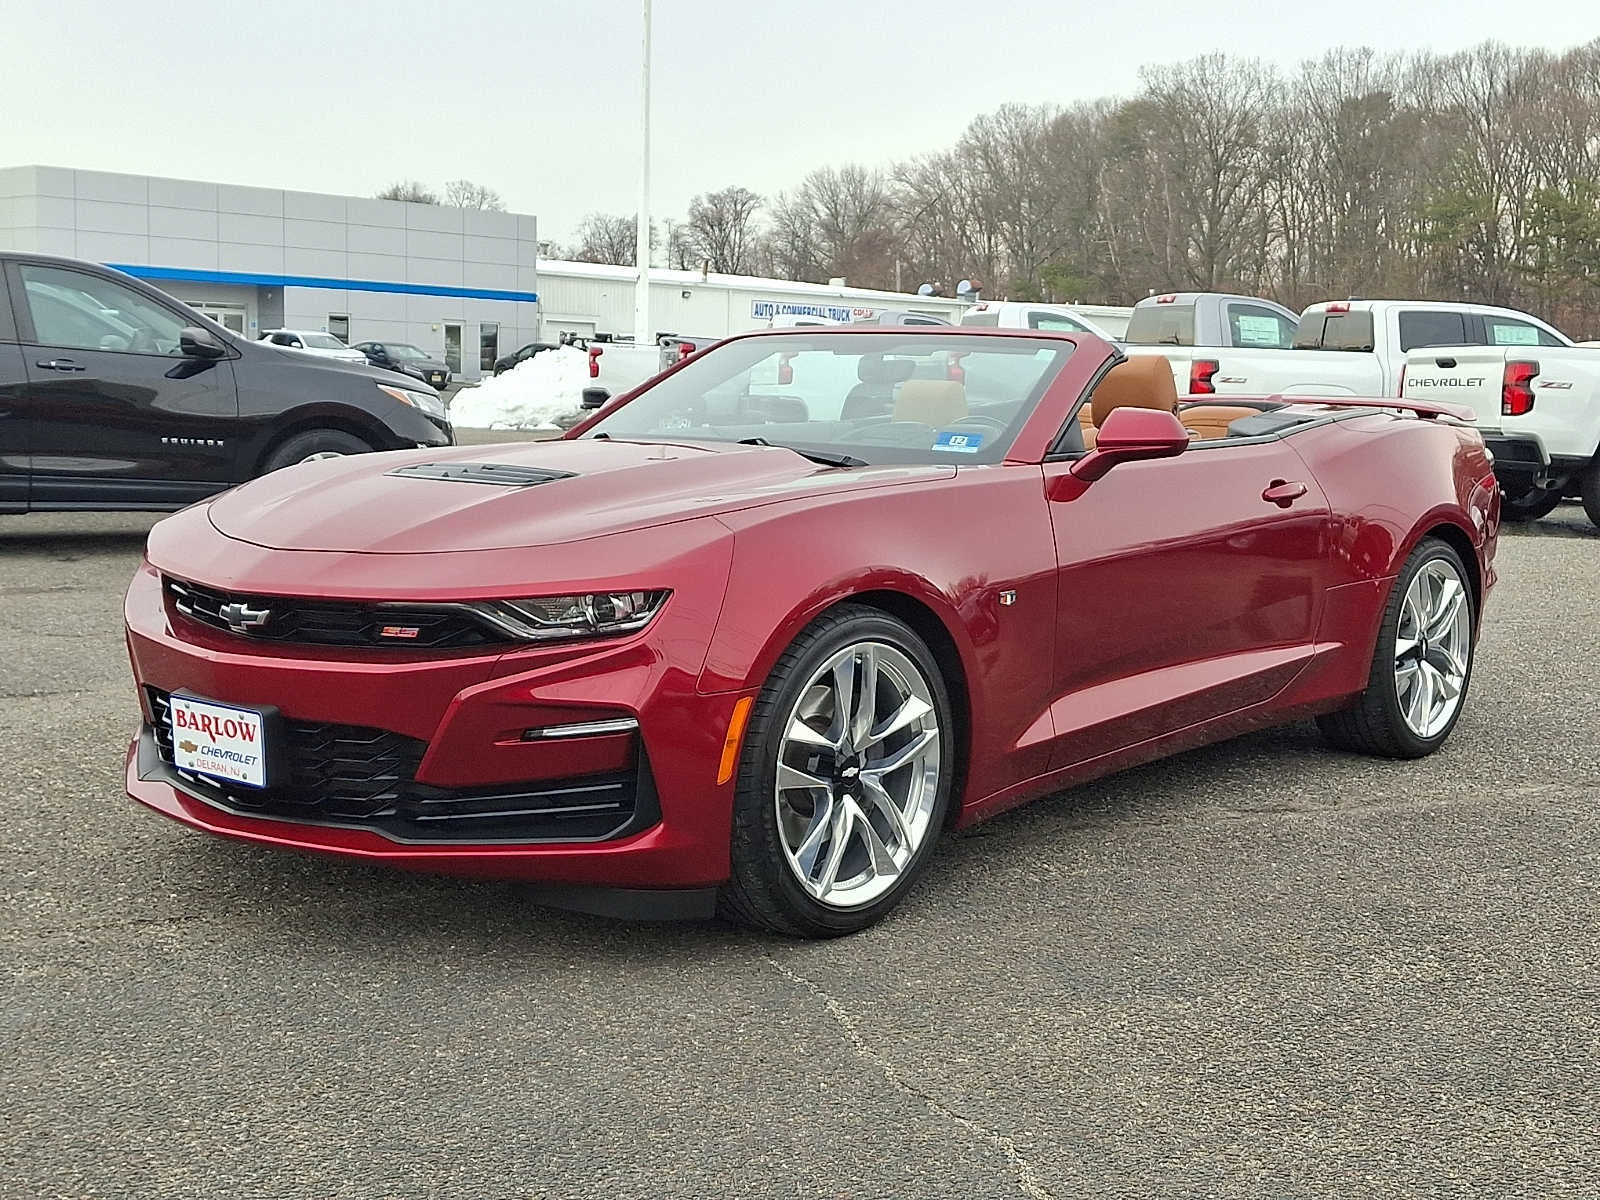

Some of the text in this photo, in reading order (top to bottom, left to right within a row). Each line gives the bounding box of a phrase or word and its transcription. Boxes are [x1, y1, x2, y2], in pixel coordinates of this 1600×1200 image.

[828, 308, 851, 322] TRUCK
[1408, 378, 1485, 387] CHEVROLET
[161, 437, 224, 446] EQUINOX
[175, 708, 257, 742] BARLOW
[201, 745, 258, 767] CHEVROLET
[230, 766, 240, 777] NJ
